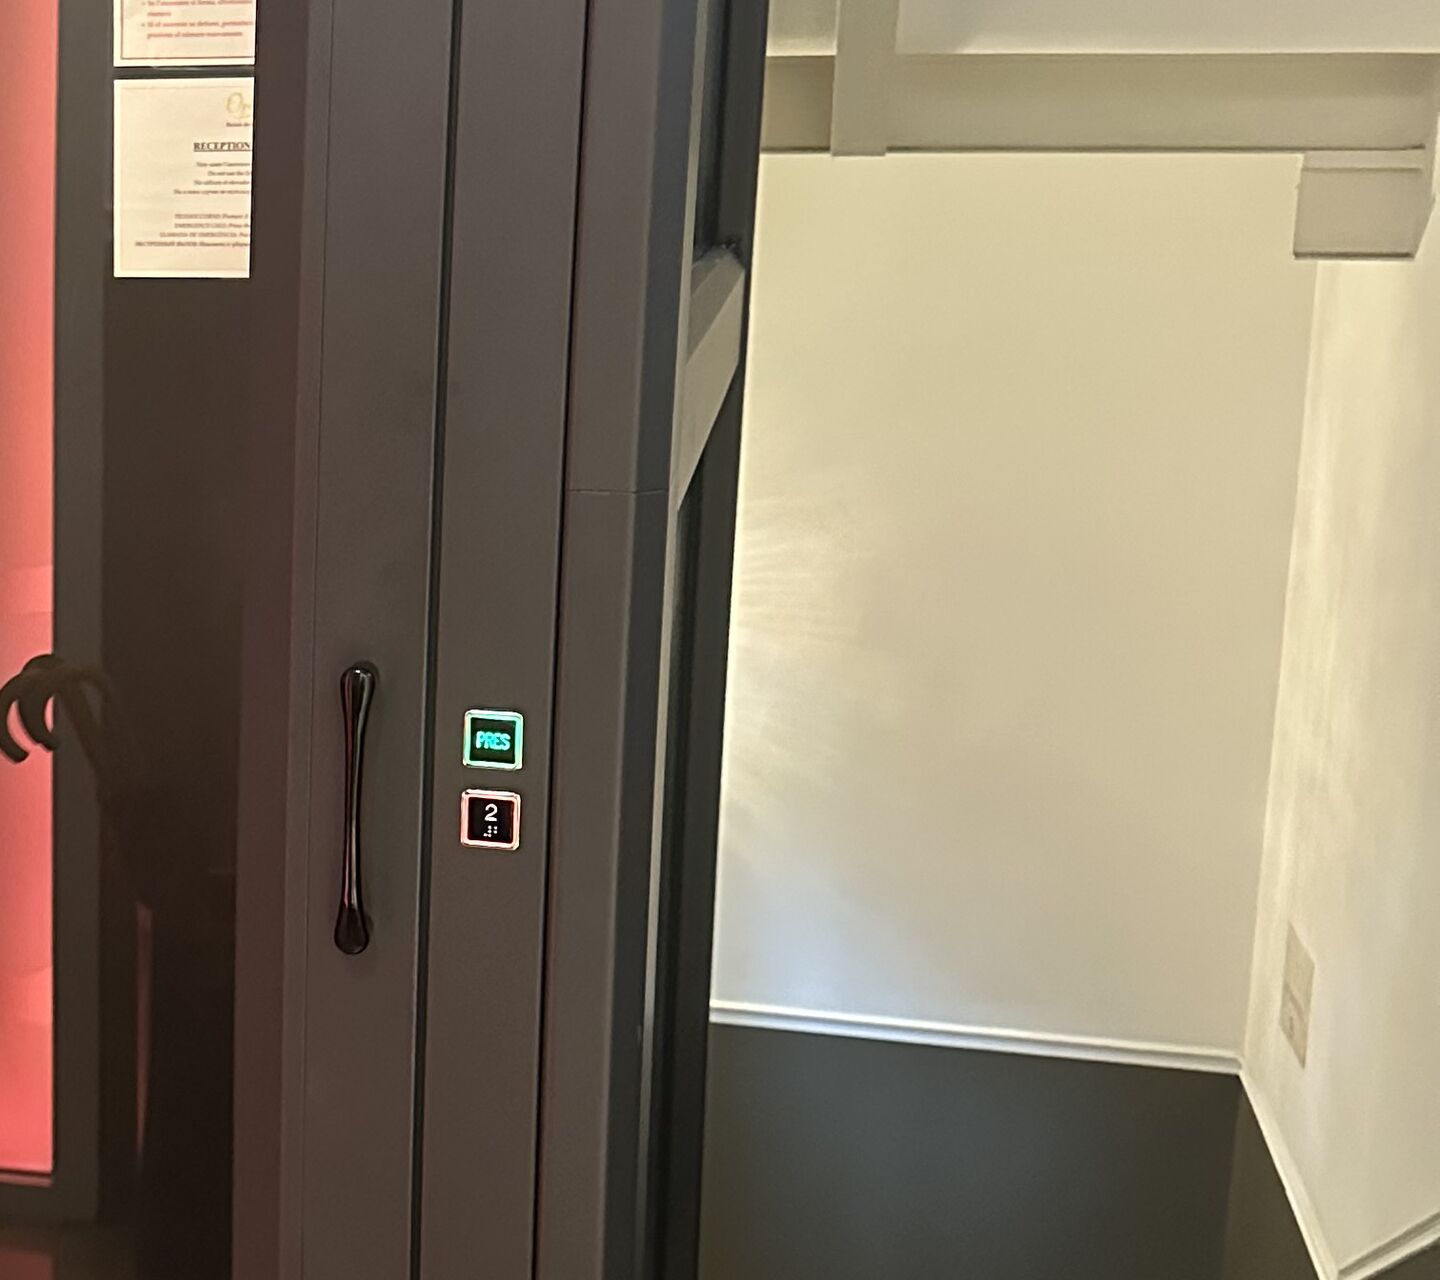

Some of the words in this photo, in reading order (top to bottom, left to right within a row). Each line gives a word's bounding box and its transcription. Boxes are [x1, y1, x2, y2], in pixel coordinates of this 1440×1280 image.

[193, 141, 251, 152] RECEPTION
[475, 730, 511, 751] PRES
[484, 803, 498, 822] 2
